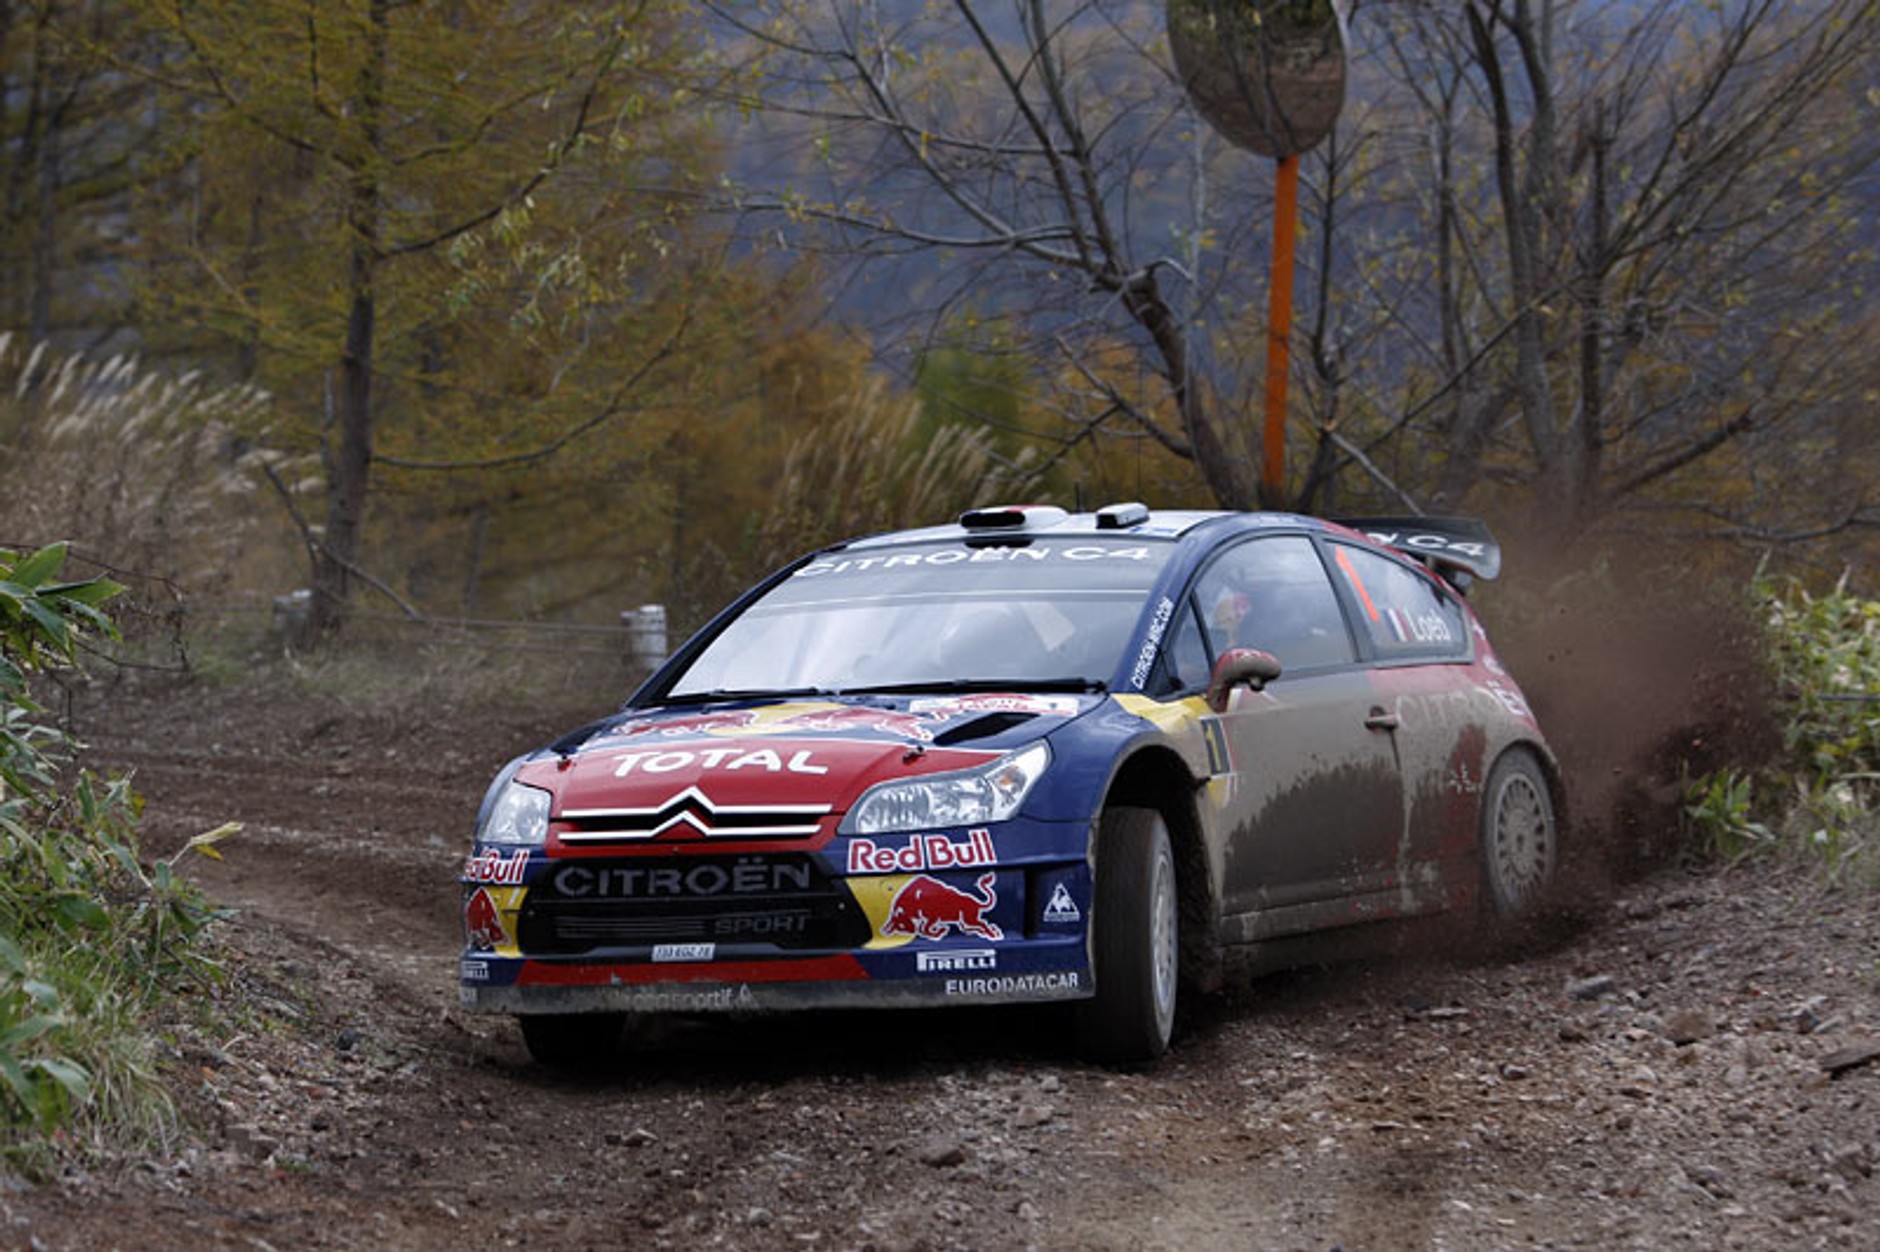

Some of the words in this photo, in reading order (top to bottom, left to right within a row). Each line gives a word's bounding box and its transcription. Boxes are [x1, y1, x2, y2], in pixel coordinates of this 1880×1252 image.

[1061, 547, 1148, 561] C4
[1406, 535, 1485, 556] C4
[1403, 607, 1451, 641] Loeb
[614, 749, 828, 777] TOTAL
[849, 833, 925, 872] Red
[924, 829, 997, 869] Bull
[554, 858, 810, 897] CITROËN
[714, 914, 809, 935] SPORT
[916, 949, 997, 971] PIRELLI
[945, 972, 1079, 996] EURODATACAR
